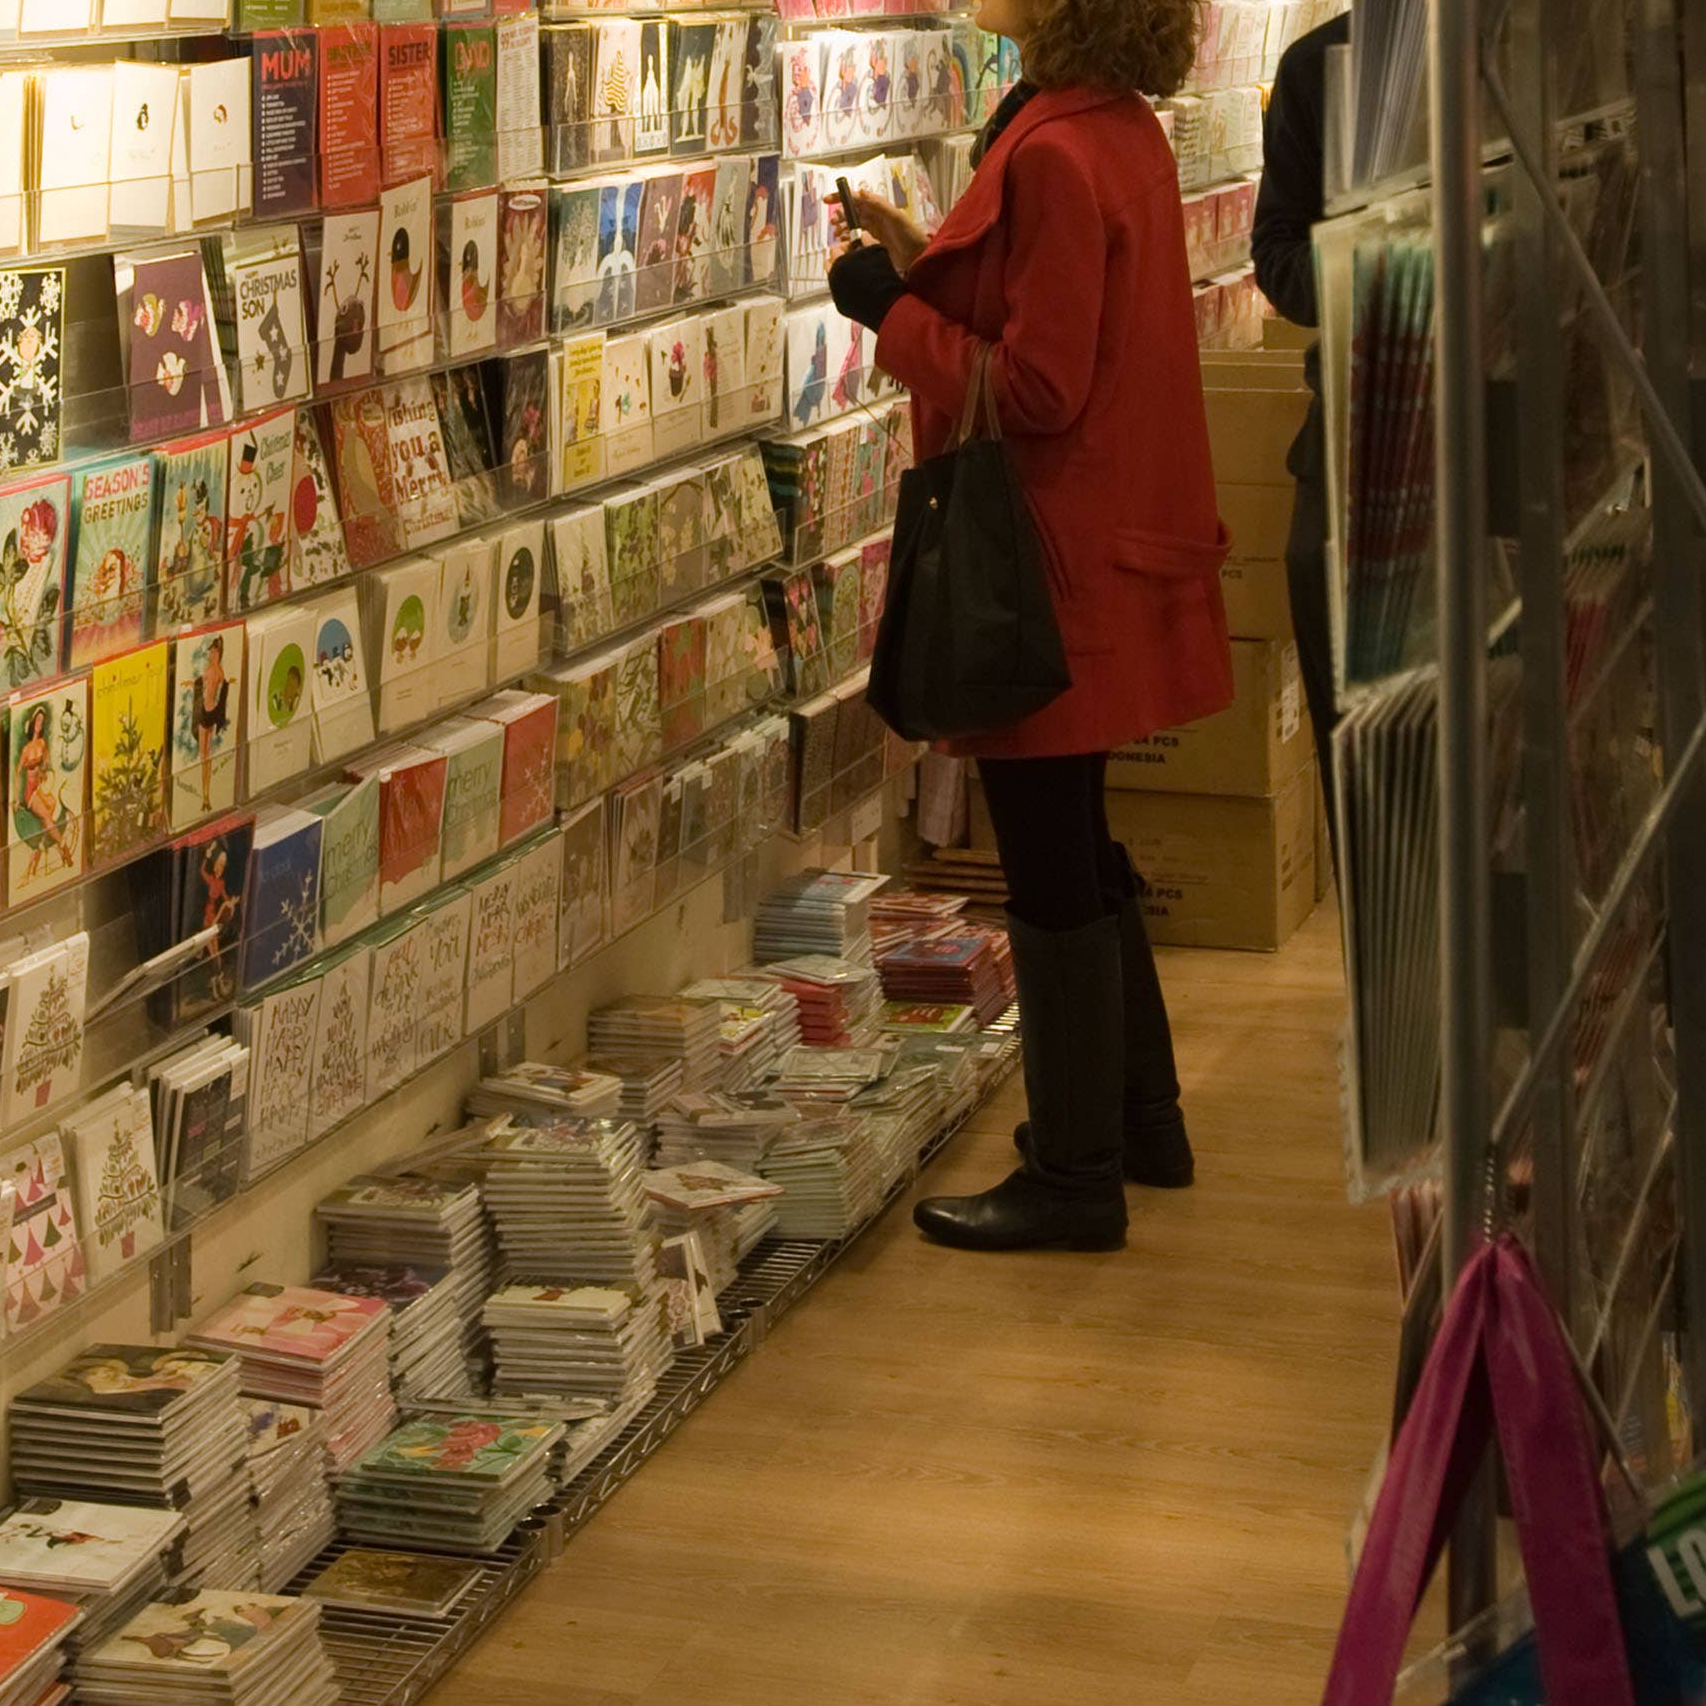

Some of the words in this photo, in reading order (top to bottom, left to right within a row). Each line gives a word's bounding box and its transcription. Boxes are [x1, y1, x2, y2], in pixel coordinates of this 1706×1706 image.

[261, 49, 312, 82] MUM
[388, 41, 432, 67] SISTER
[240, 269, 297, 300] CHRISTMAS
[242, 298, 266, 321] SON
[427, 429, 442, 456] a
[82, 462, 151, 501] SEASON'S
[394, 468, 447, 506] Merry
[83, 491, 149, 526] GREETINGS
